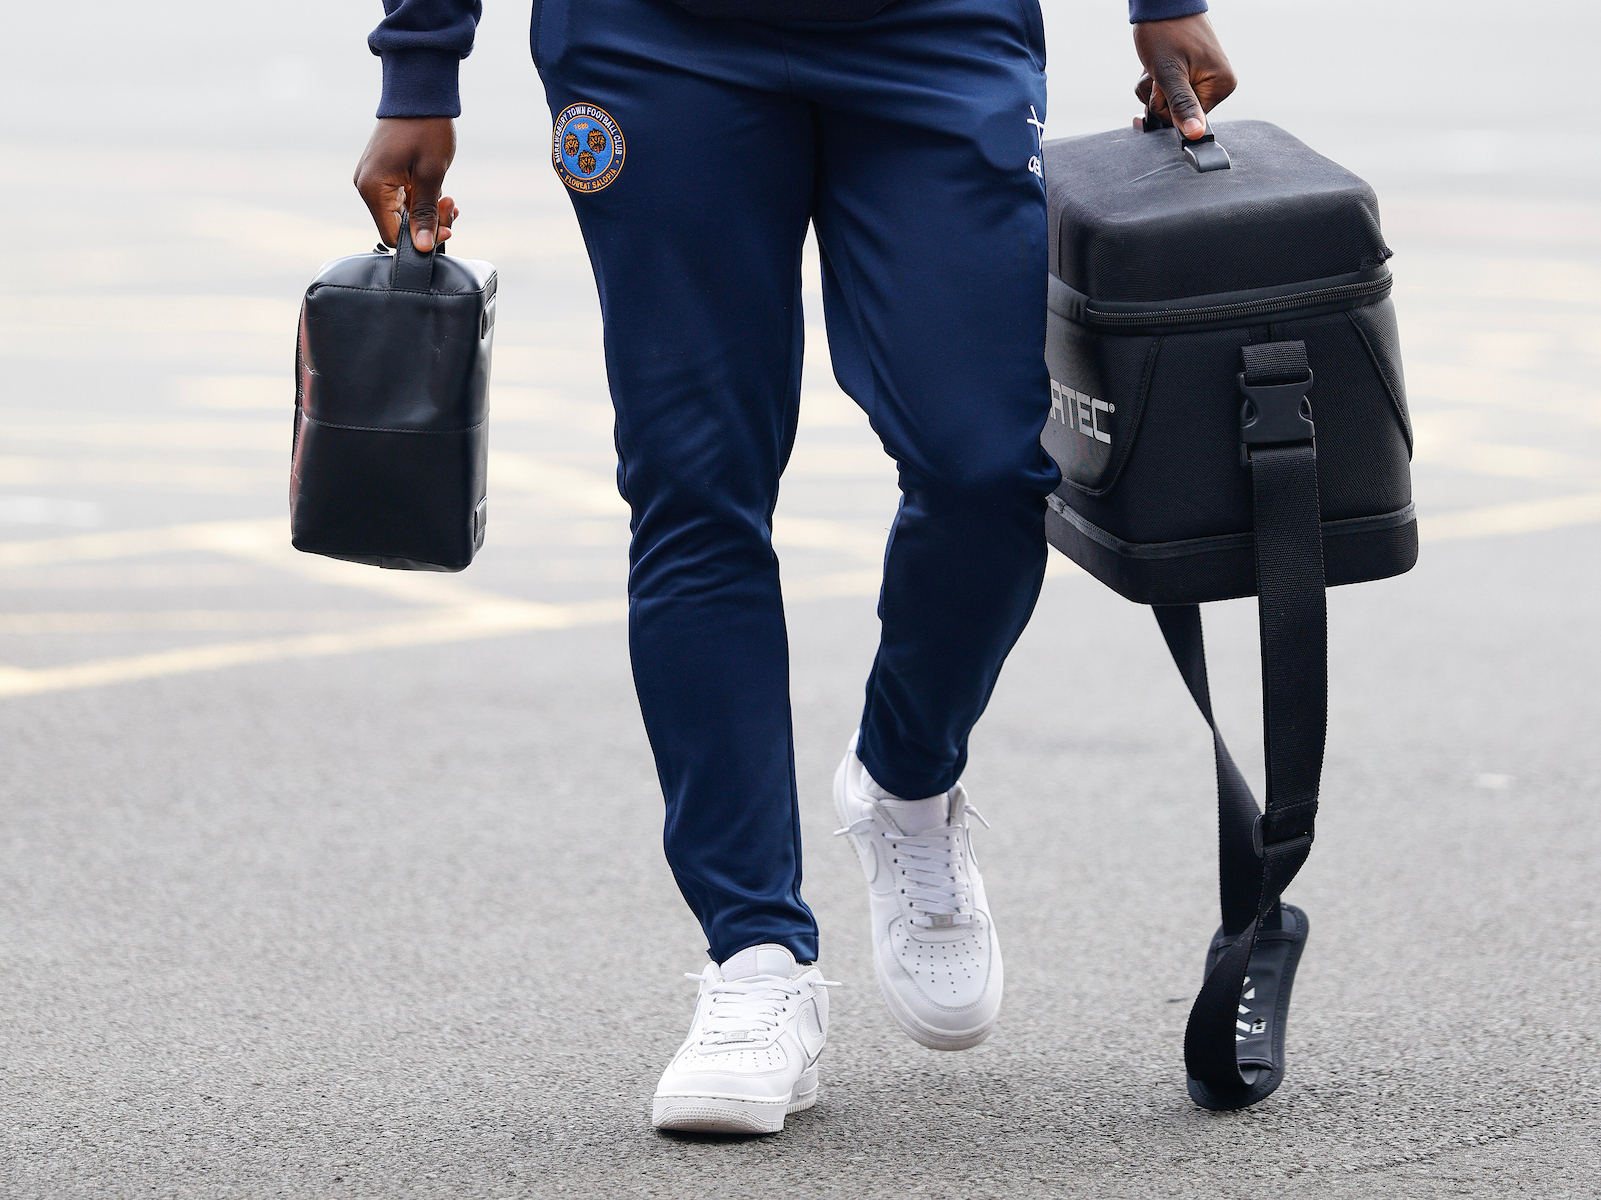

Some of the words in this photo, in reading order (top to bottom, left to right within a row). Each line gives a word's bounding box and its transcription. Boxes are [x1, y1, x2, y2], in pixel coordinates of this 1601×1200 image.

[567, 106, 586, 118] TOWN
[587, 107, 617, 135] FOOTBALL
[614, 134, 623, 155] CLUB
[592, 168, 617, 189] SALOPIA
